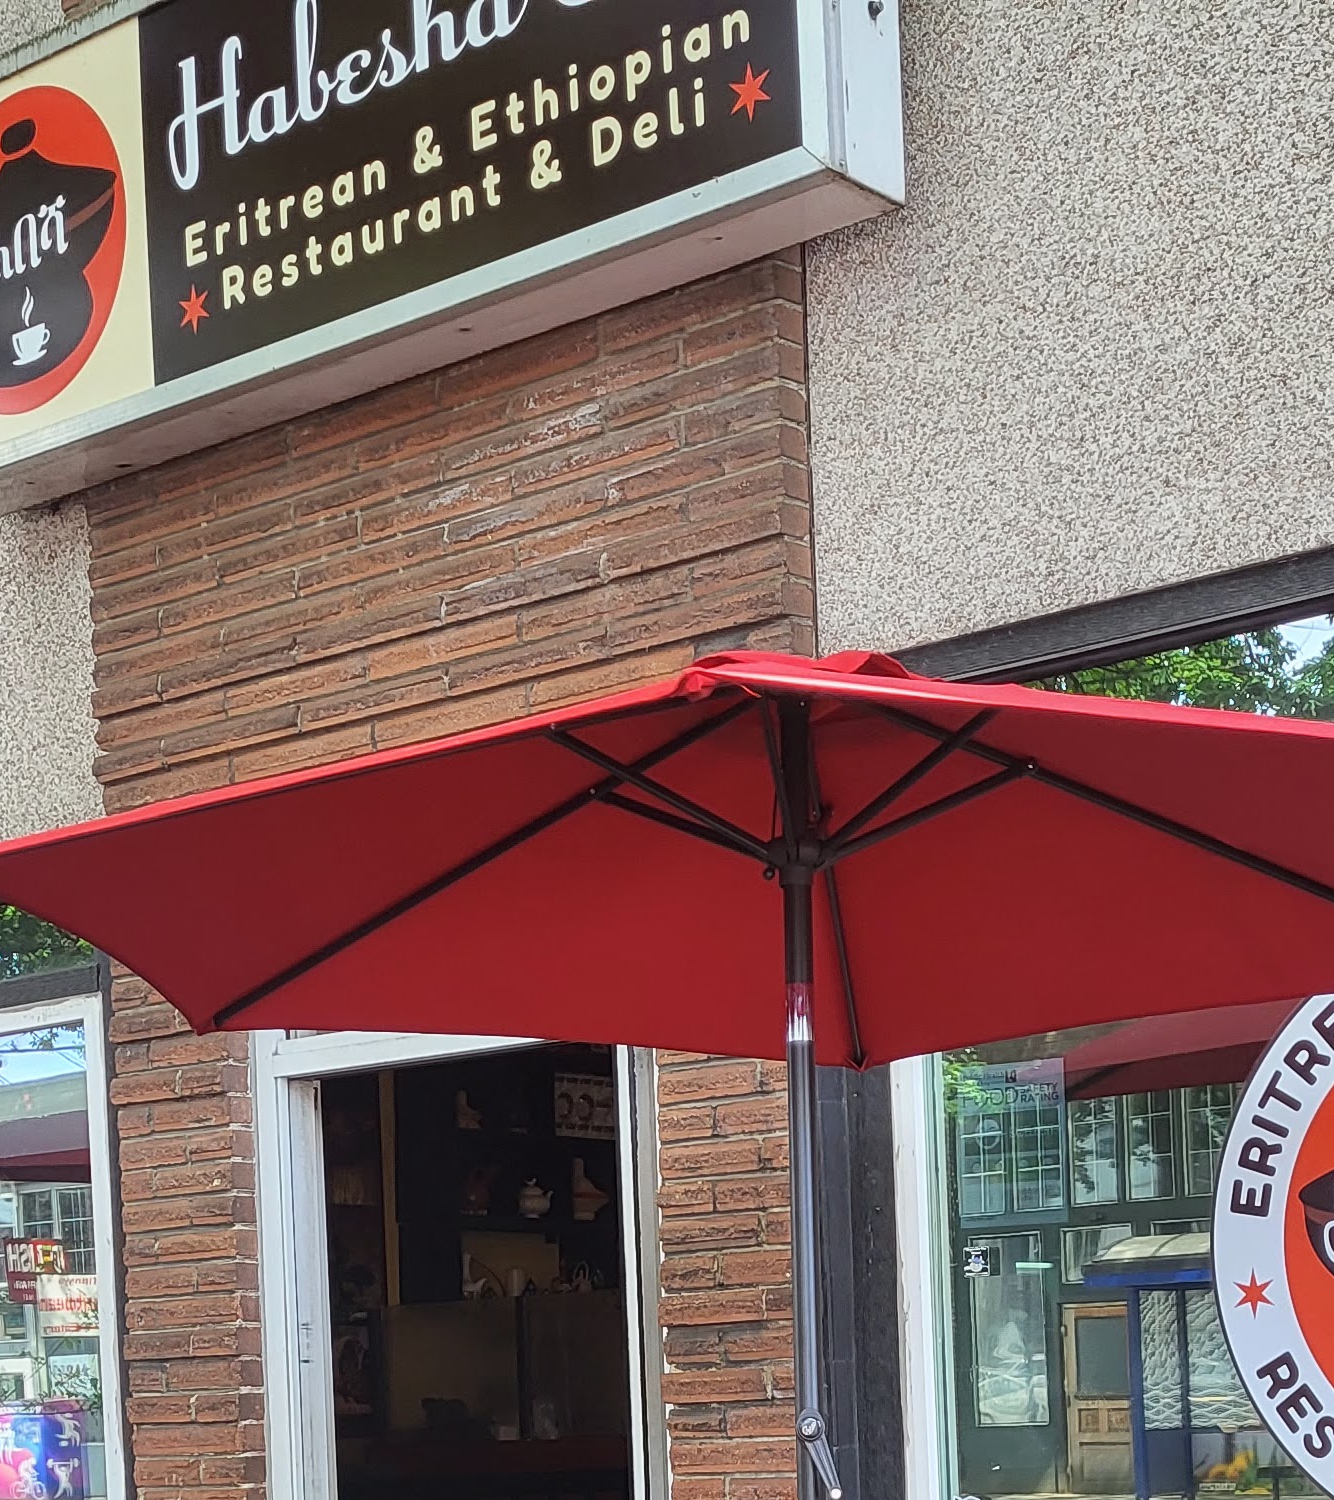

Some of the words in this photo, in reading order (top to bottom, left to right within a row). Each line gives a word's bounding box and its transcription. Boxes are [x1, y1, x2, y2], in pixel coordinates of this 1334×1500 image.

[169, 0, 529, 190] Habesha
[185, 159, 386, 267] Eritrean
[413, 125, 443, 174] &
[470, 9, 750, 152] Ethiopian
[222, 165, 501, 310] Restaurant
[530, 139, 562, 189] &
[592, 77, 705, 167] Deli
[1020, 1091, 1059, 1103] RATING
